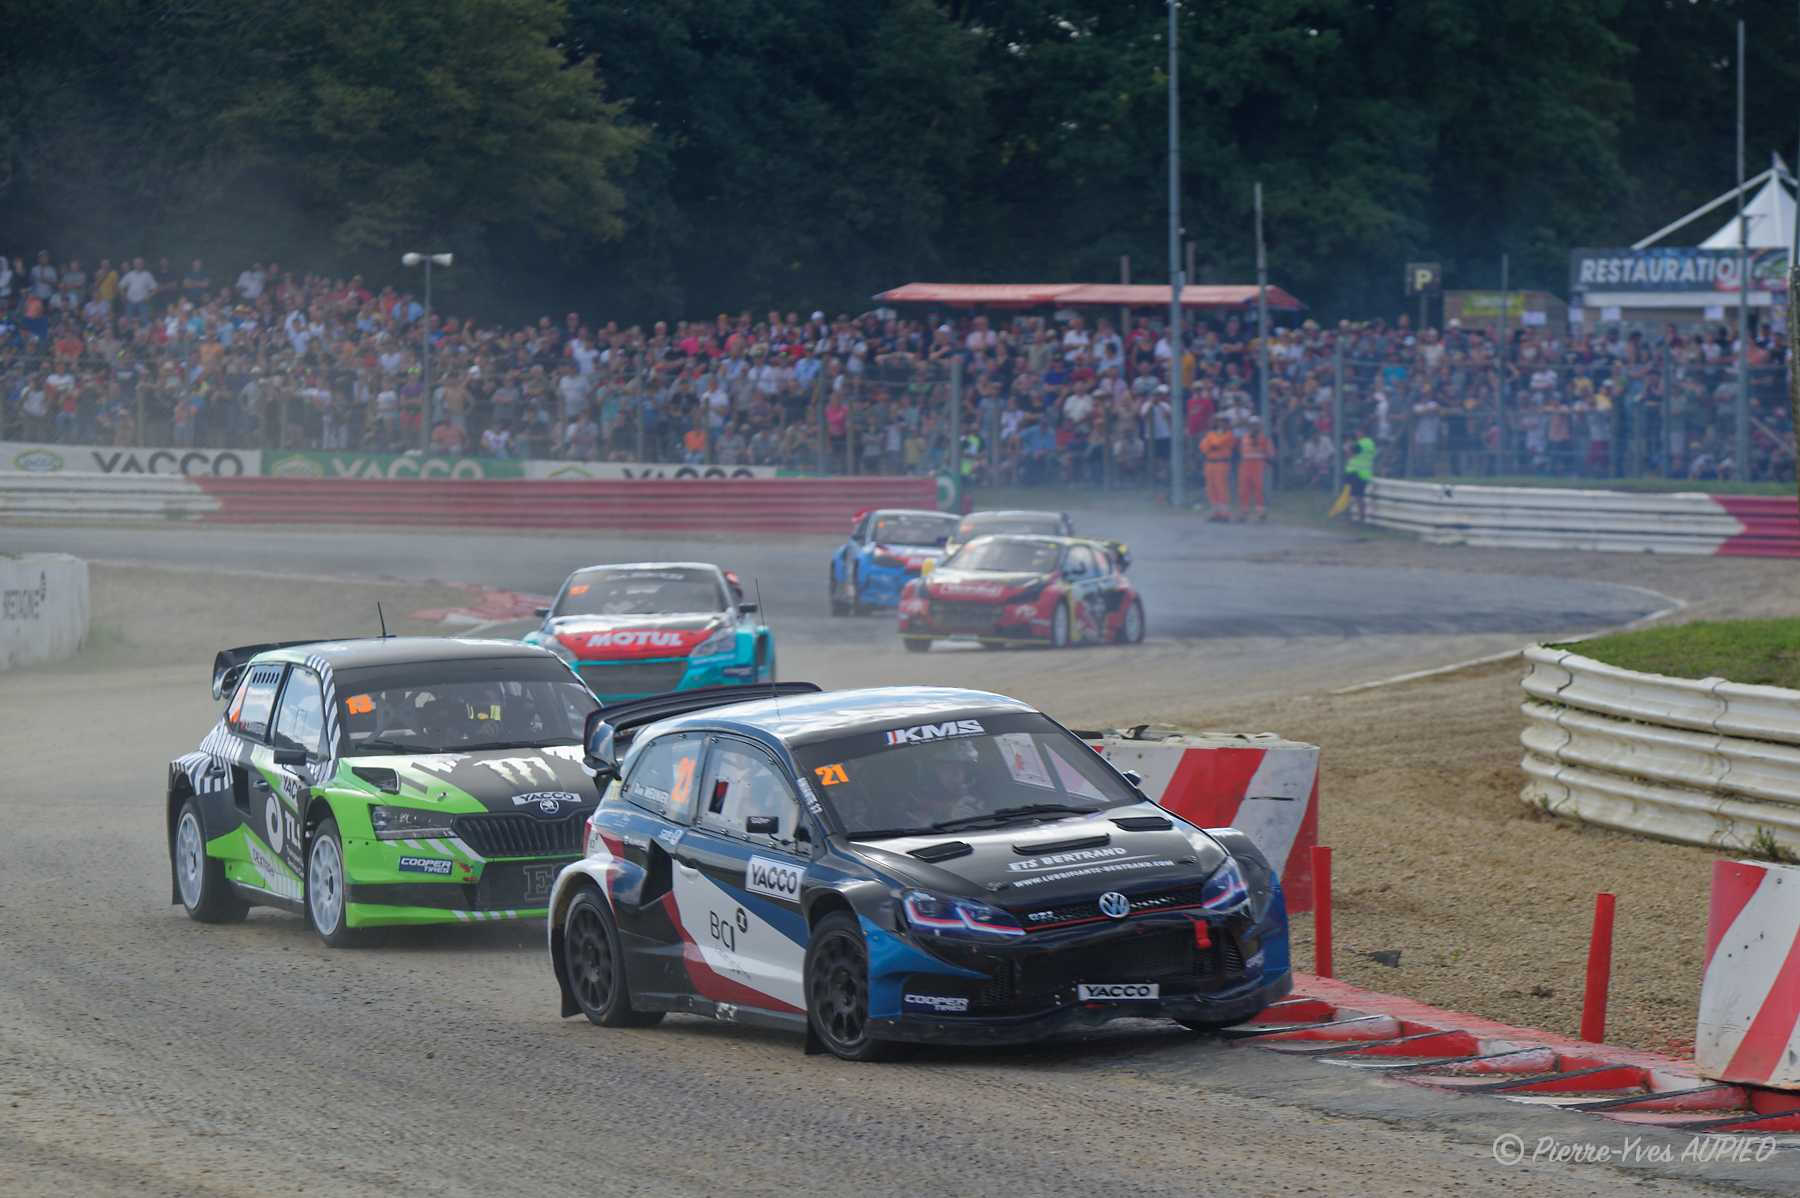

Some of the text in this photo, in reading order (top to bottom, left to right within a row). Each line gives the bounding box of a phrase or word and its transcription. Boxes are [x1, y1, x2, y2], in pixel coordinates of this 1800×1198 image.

[1415, 269, 1433, 291] P
[586, 631, 684, 648] MOTUL
[814, 763, 849, 786] 21
[521, 791, 575, 802] YACCO
[400, 857, 452, 869] COOPER
[1039, 847, 1128, 866] BERTRAND
[751, 863, 799, 894] YACCO
[904, 993, 969, 1006] COOPER
[1085, 985, 1151, 998] YACCO
